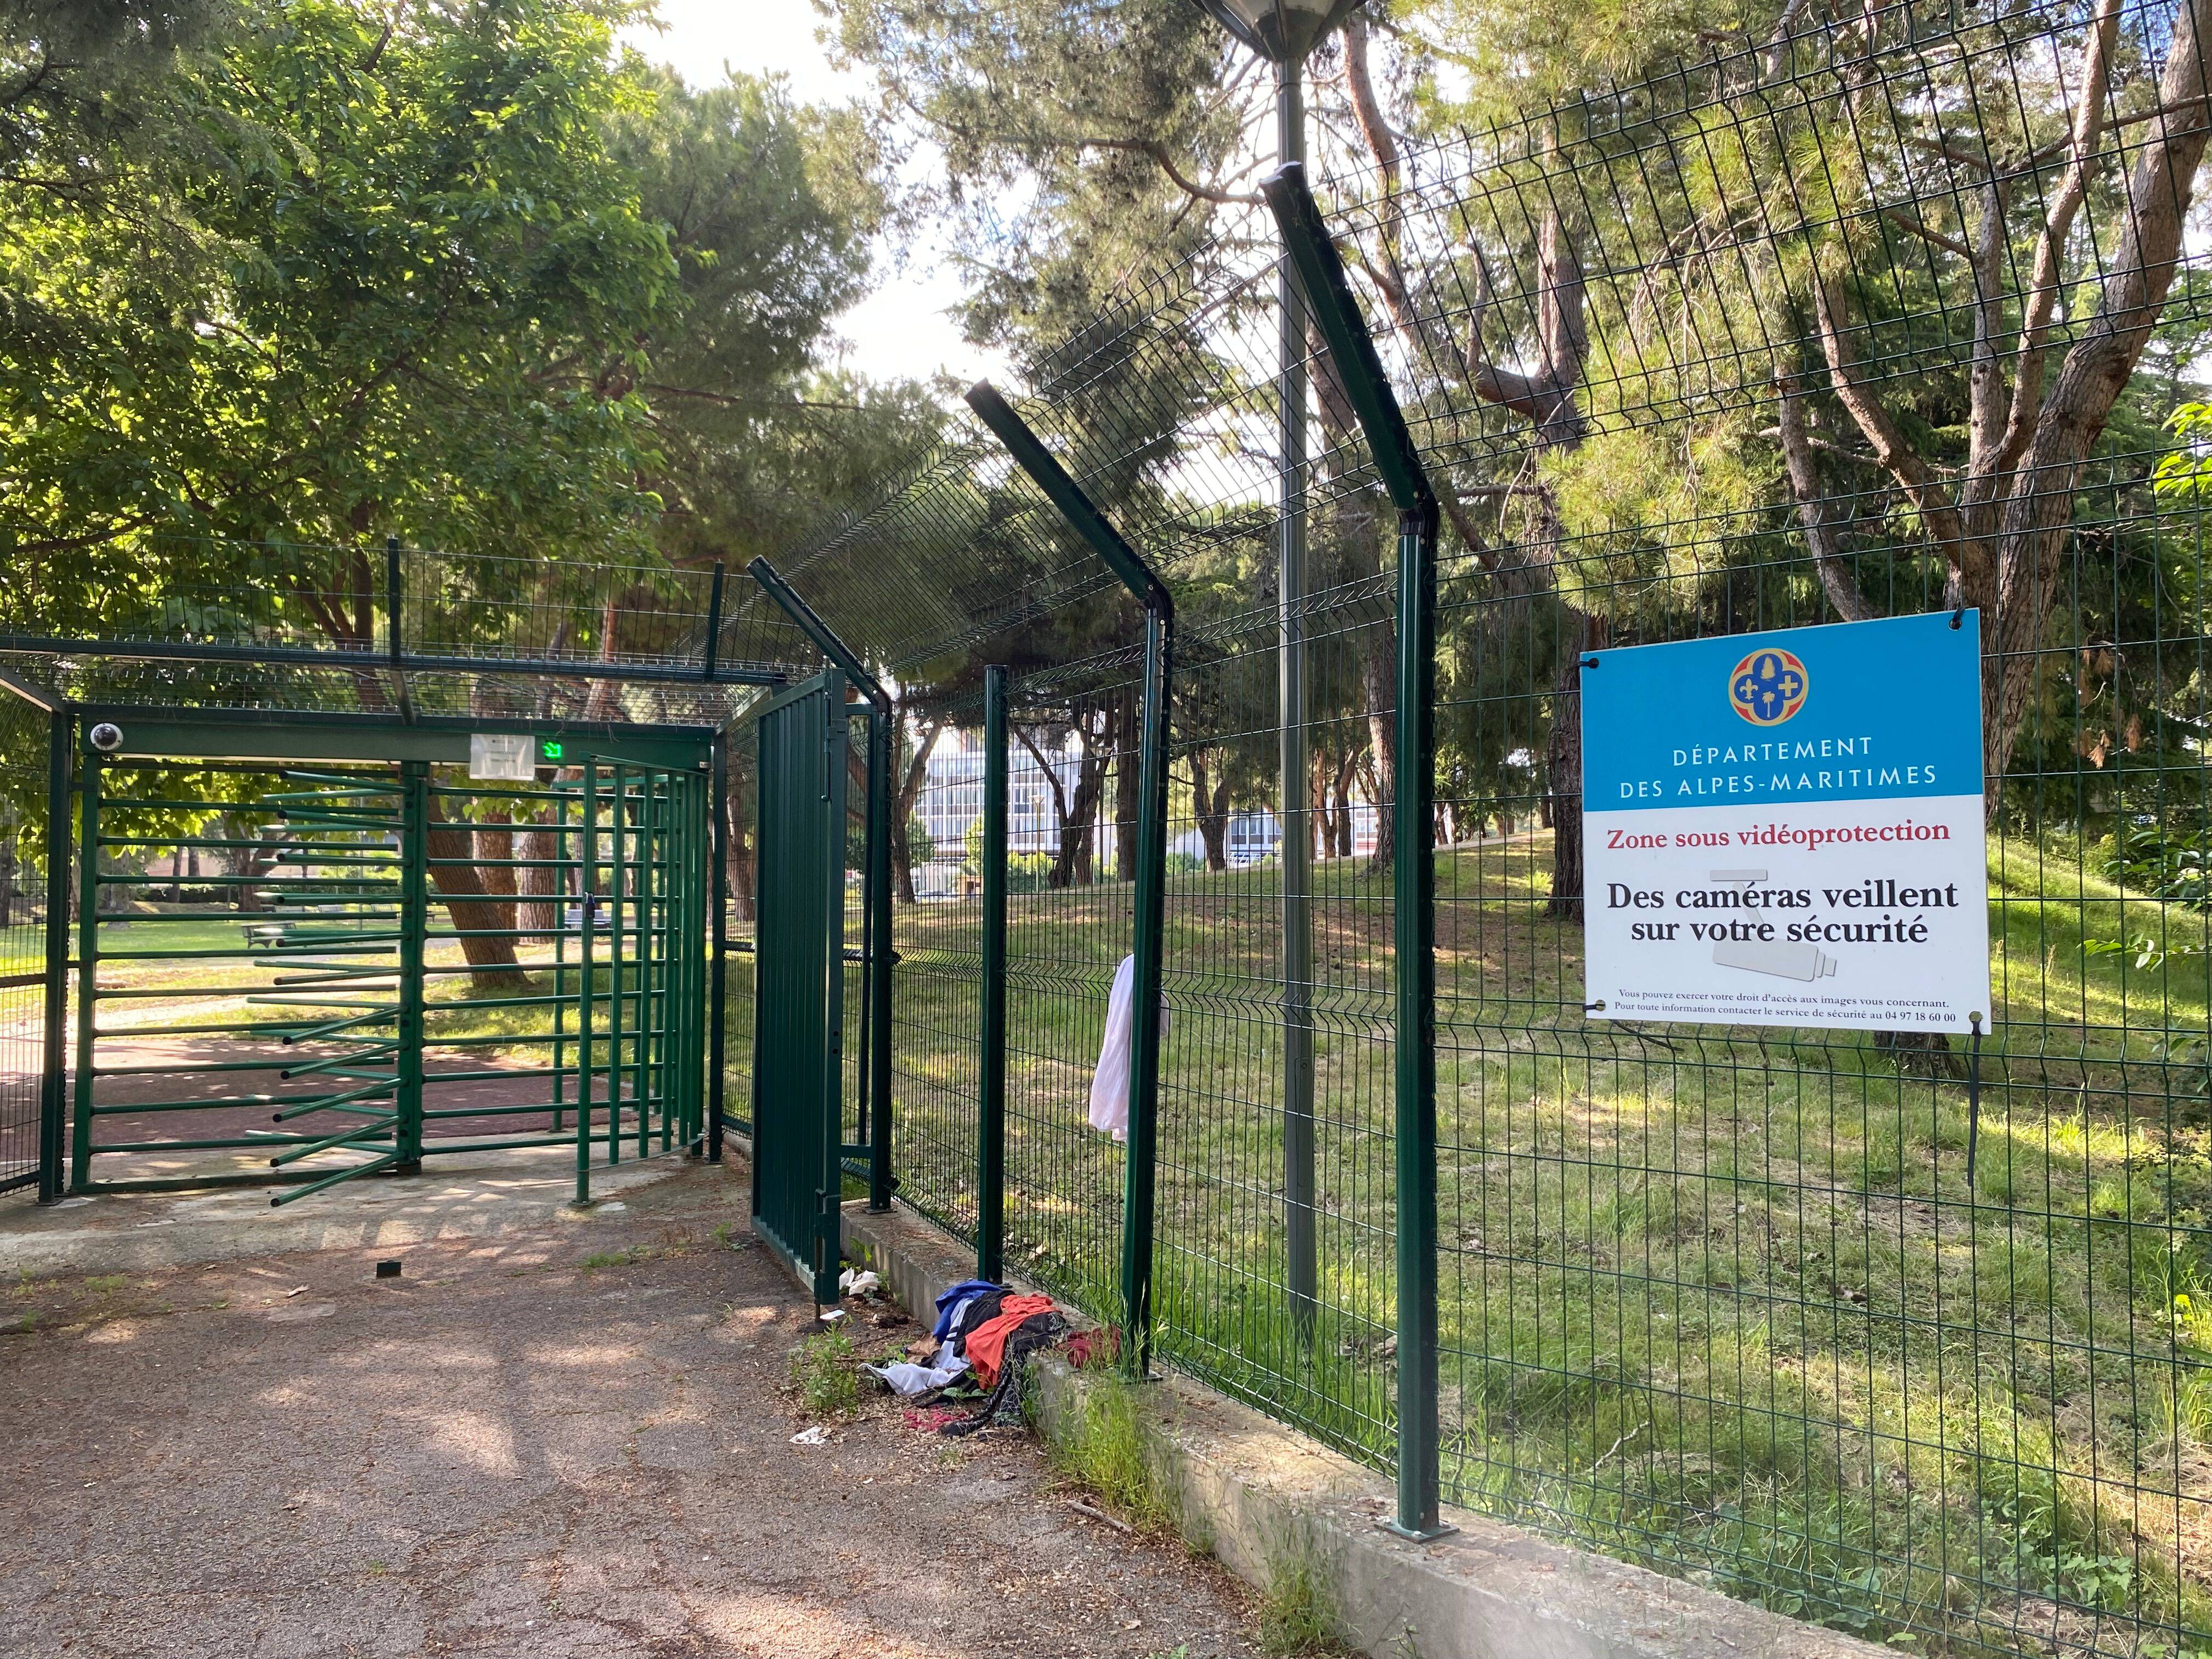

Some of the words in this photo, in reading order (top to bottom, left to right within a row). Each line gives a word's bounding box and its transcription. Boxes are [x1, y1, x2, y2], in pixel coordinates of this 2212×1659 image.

[1673, 736, 1872, 766] DÉPARTEMENT
[1620, 780, 1663, 798] DES
[1678, 765, 1937, 795] ALPES-MARITIMES
[1607, 829, 1667, 849] Zone
[1675, 832, 1730, 847] sous
[1737, 819, 1951, 851] vidéoprotection
[1606, 883, 1664, 909] Des
[1675, 881, 1811, 909] caméras
[1821, 879, 1959, 908] veillent
[1631, 922, 1680, 941] sur
[1689, 918, 1775, 942] votre
[1787, 914, 1928, 943] sécurité
[1615, 1001, 1635, 1010] Pour
[1662, 1003, 1716, 1014] information
[1764, 1007, 1773, 1015] le
[1775, 1008, 1810, 1017] service
[1812, 1008, 1825, 1017] de
[1827, 1009, 1867, 1019] sécurité
[1885, 1011, 1897, 1020] 04
[1899, 1011, 1911, 1021] 97
[1915, 1012, 1926, 1021] 18
[1928, 1013, 1941, 1022] 60
[1944, 1013, 1956, 1023] 00
[1618, 989, 1640, 998] Vous
[1642, 992, 1673, 1001] pouvez
[1736, 992, 1759, 1002] droit
[1762, 994, 1797, 1003] d'accès
[1821, 995, 1857, 1007] images
[1886, 1000, 1949, 1008] concernant.
